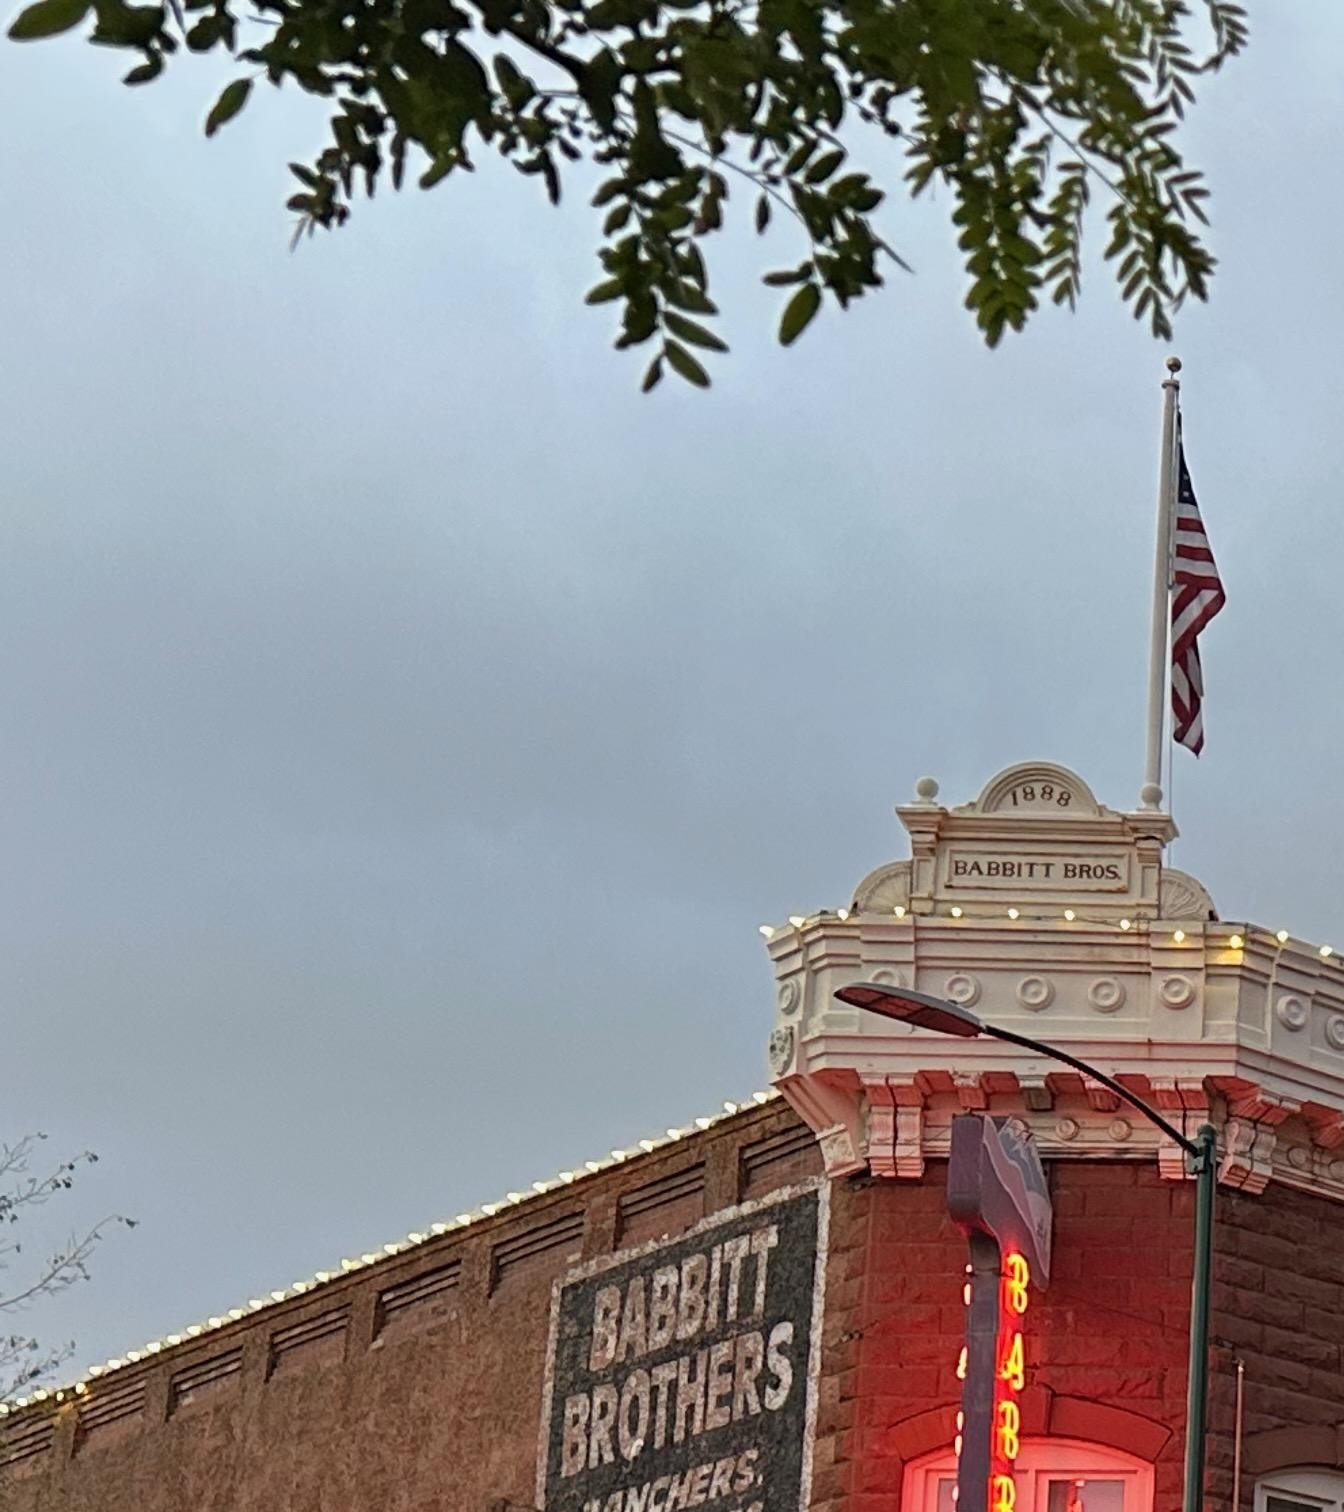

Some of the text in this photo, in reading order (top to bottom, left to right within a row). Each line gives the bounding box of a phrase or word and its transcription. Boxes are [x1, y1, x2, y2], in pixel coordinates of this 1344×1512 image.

[1010, 784, 1072, 808] 1888
[953, 859, 1122, 881] BABBITT BROS.
[589, 1224, 779, 1372] BABBITT
[561, 1321, 795, 1478] BROTHERS
